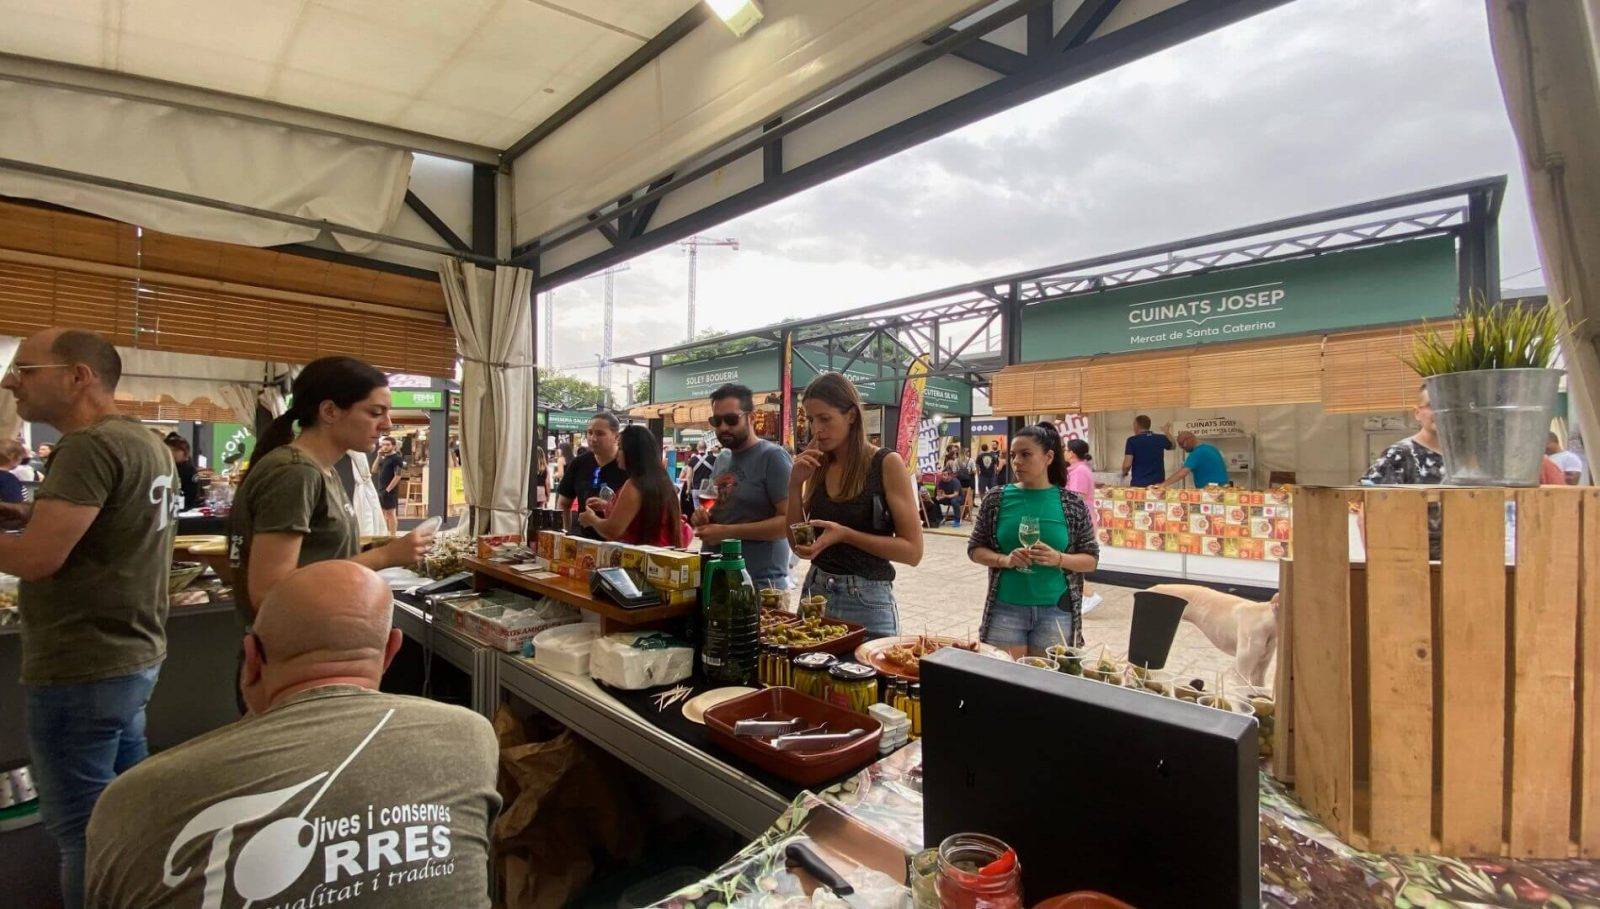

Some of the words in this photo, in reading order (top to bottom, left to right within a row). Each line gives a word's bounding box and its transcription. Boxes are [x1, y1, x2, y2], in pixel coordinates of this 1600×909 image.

[1129, 300, 1211, 324] CUINATS
[1217, 289, 1285, 312] JOSEP
[1130, 333, 1166, 345] Mercat
[1169, 331, 1183, 340] de
[1186, 327, 1219, 338] Santa
[1222, 320, 1276, 334] Caterina
[367, 805, 373, 830] i
[380, 804, 451, 825] conserves
[372, 878, 380, 892] i
[387, 857, 456, 887] tradició
